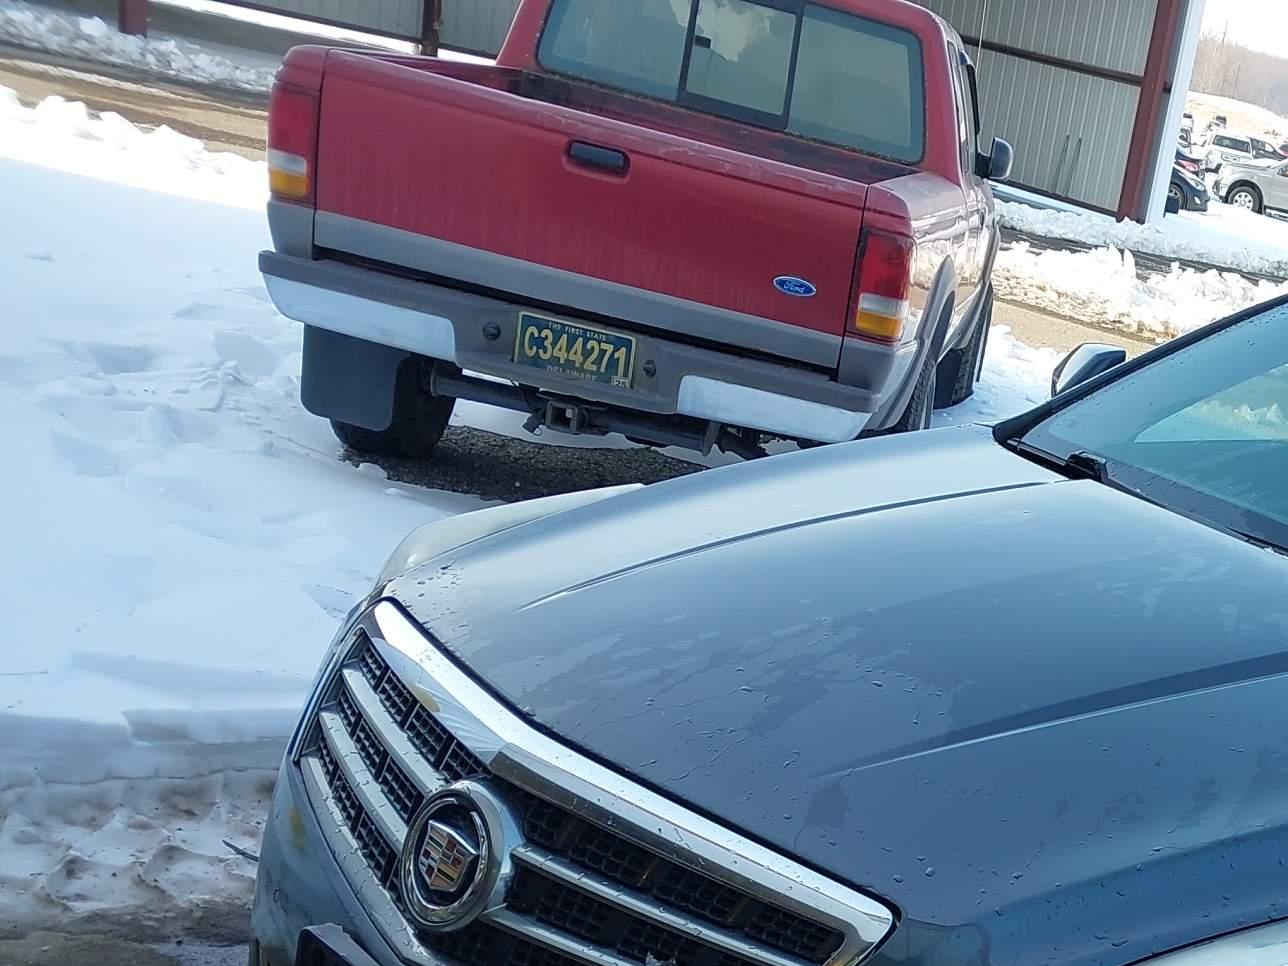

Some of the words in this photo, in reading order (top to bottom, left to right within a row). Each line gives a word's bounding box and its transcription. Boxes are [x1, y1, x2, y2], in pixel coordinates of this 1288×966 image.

[548, 322, 562, 331] THE
[564, 326, 584, 337] FIRST
[586, 330, 607, 342] STATE
[523, 325, 627, 378] C344271
